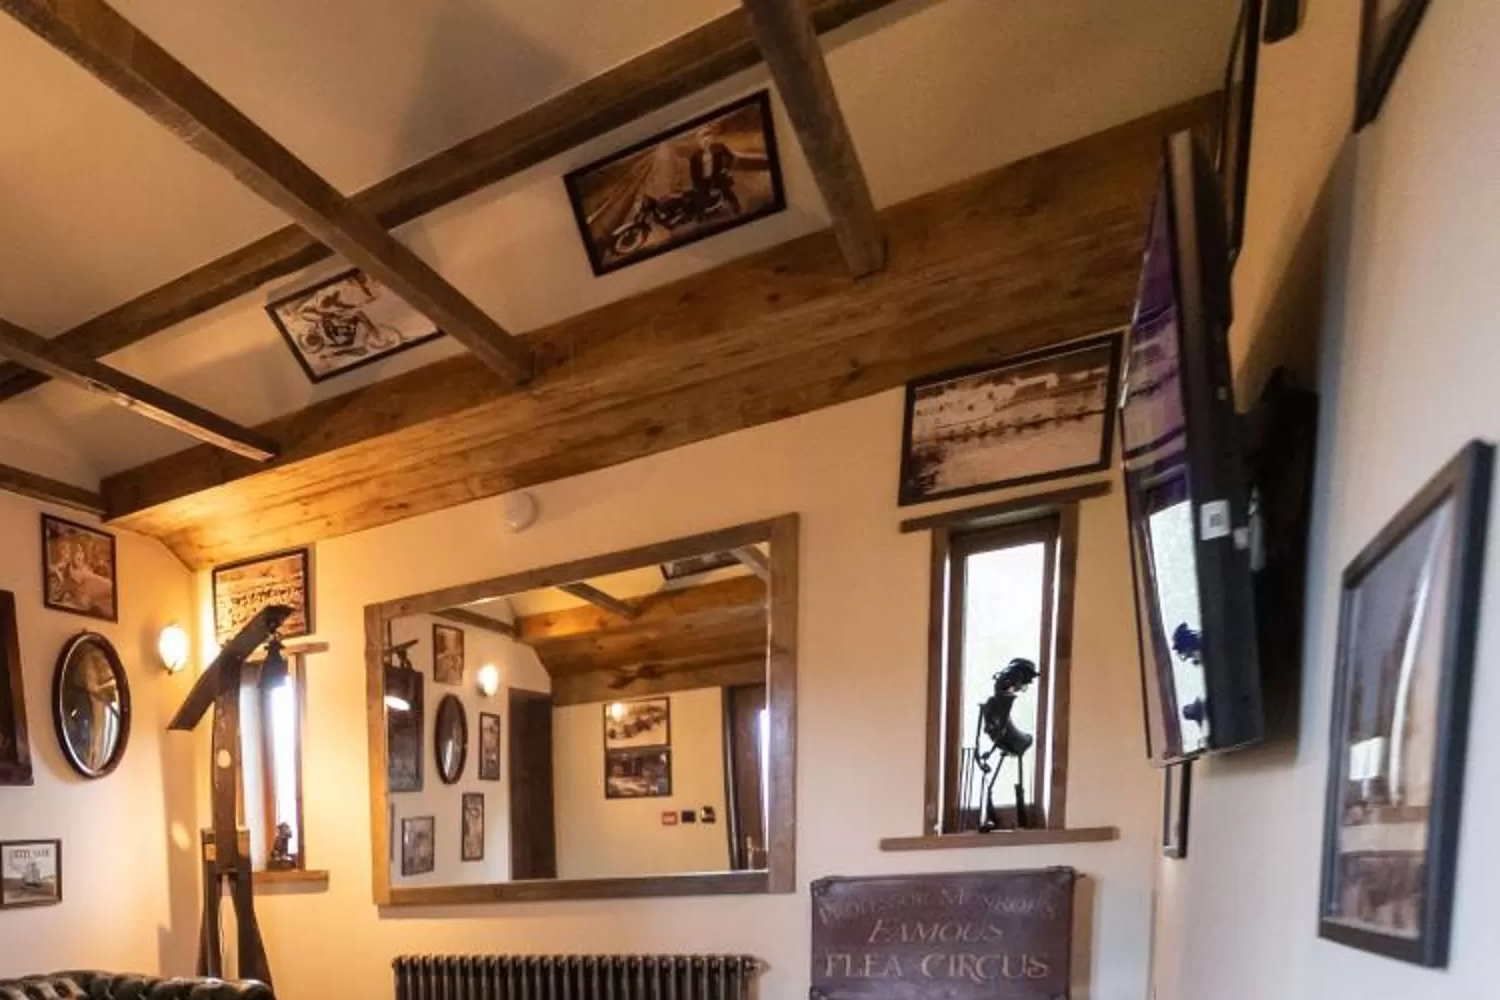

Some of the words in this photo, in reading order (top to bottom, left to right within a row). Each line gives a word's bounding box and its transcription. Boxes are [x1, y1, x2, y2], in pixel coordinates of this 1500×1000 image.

[868, 918, 1004, 943] FAMOUS
[825, 952, 903, 977] FLEA
[920, 952, 1050, 985] CIRCUS
